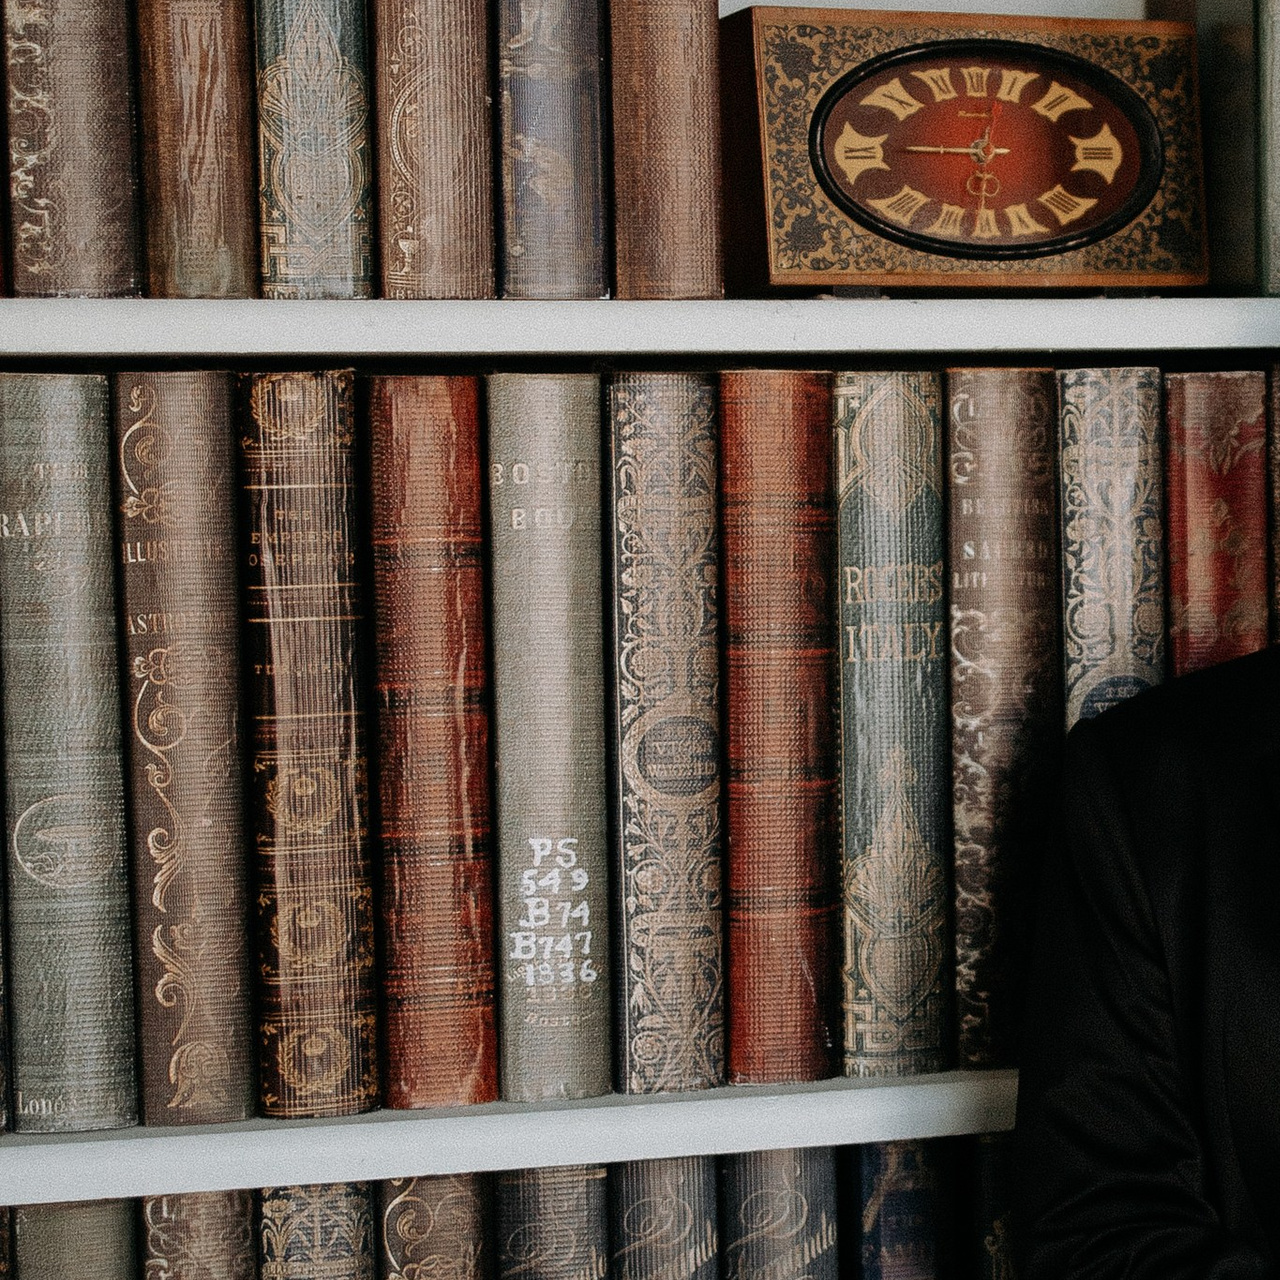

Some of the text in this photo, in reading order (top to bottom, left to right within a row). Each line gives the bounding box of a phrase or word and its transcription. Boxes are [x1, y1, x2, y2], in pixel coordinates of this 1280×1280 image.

[843, 562, 943, 605] ROGERS
[846, 621, 943, 661] ITALY
[529, 838, 578, 868] PS
[521, 868, 589, 896] 549
[519, 898, 590, 928] B74
[509, 931, 592, 959] B747
[526, 959, 598, 986] 1836
